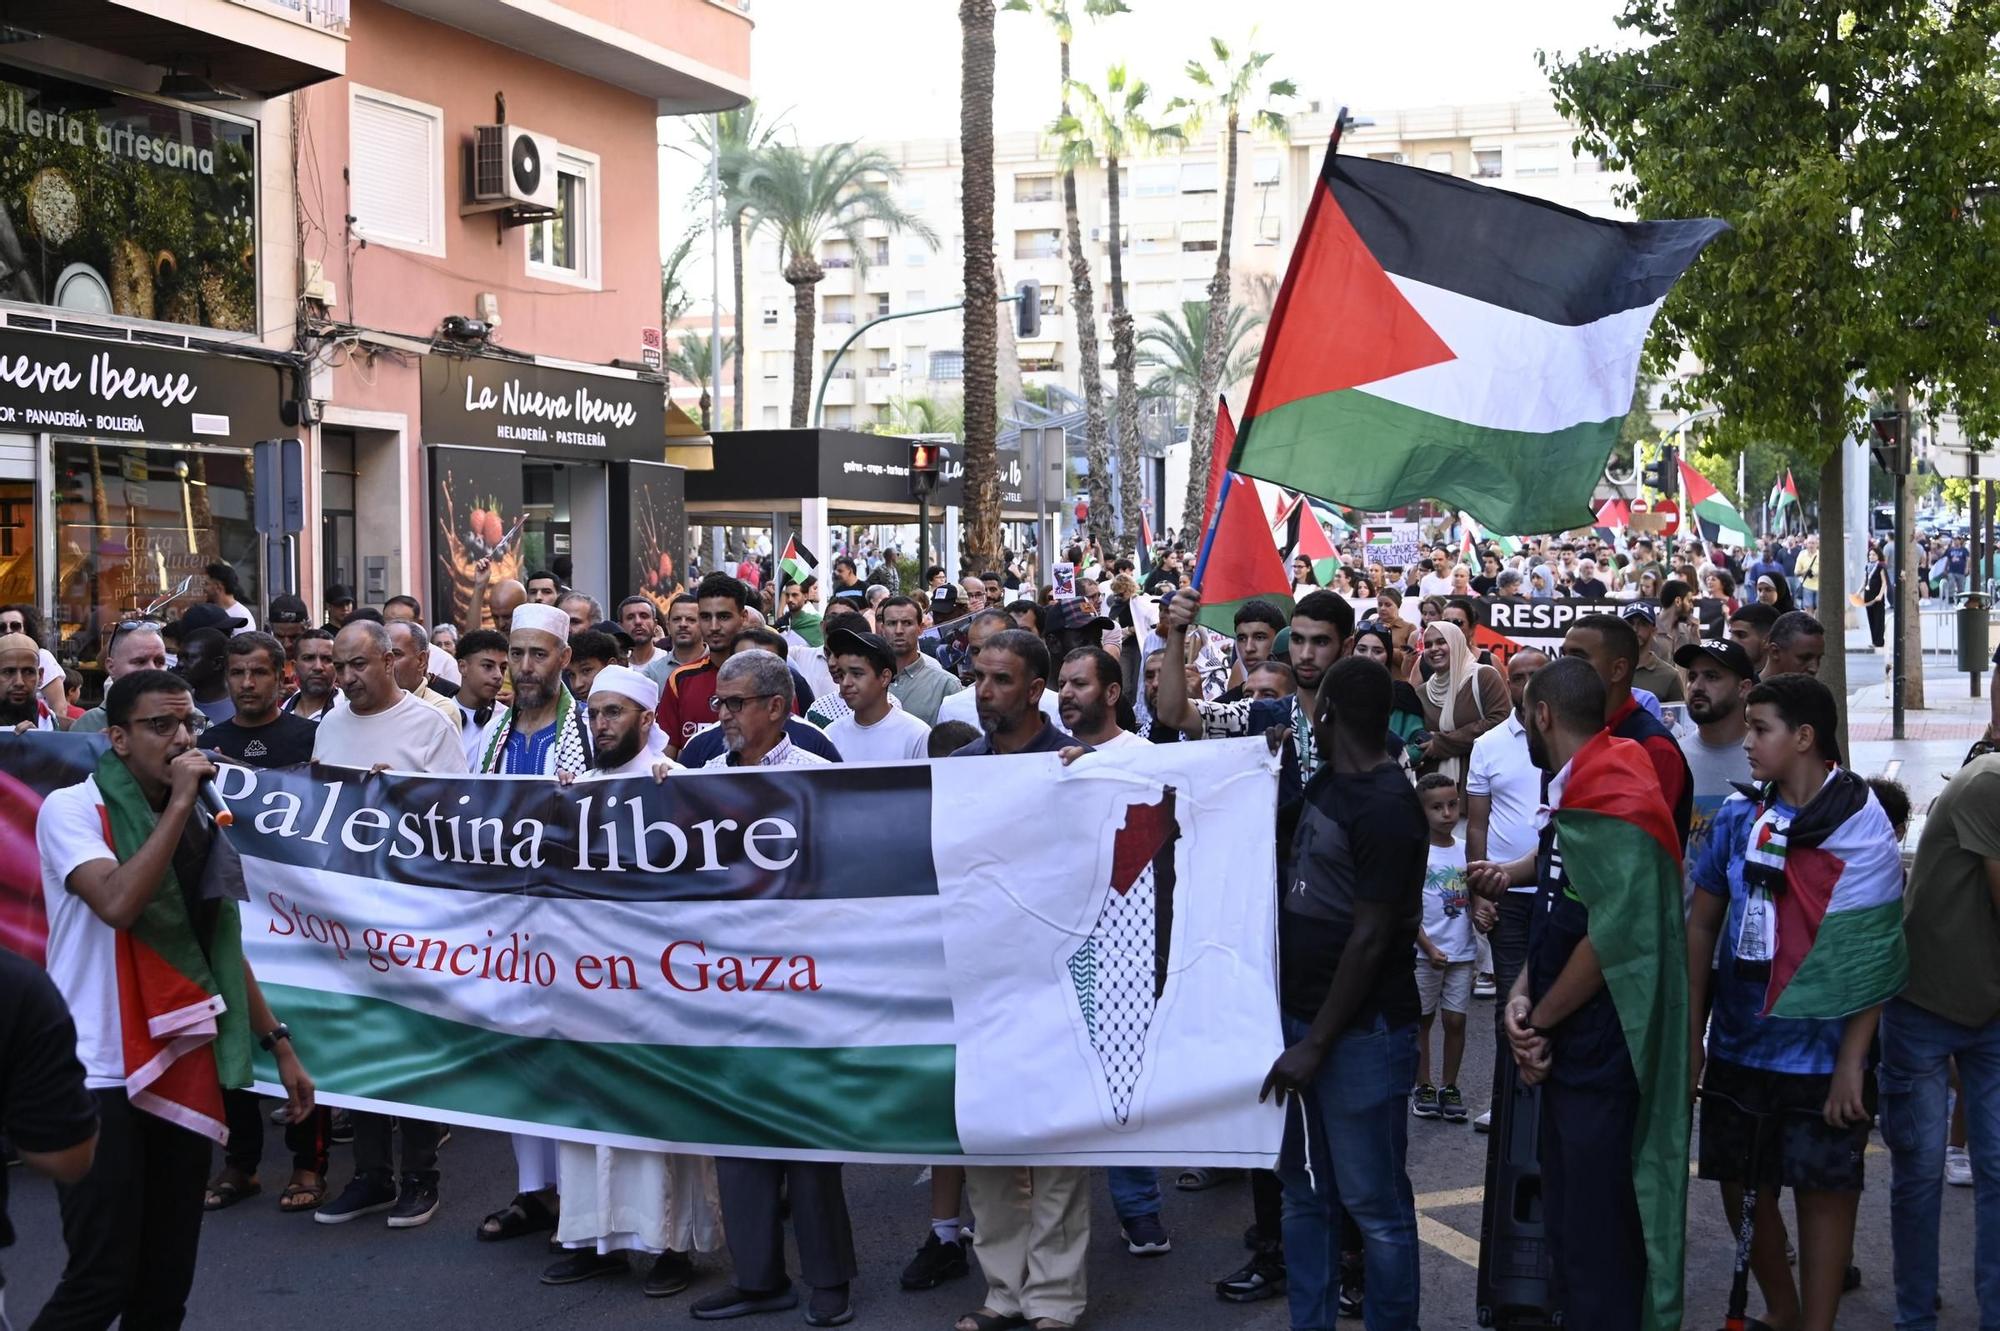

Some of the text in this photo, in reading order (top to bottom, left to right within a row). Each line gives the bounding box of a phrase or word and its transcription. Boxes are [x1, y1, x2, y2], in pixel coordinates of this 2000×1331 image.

[96, 125, 214, 175] artesana
[90, 351, 198, 408] Ibense
[466, 375, 637, 429] La Nueva Ibense
[26, 408, 88, 428] PANADERÍA
[96, 414, 145, 433] BOLLERÍA
[497, 425, 606, 447] HELADERÍA PASTELERÍA
[124, 533, 172, 551] Carta
[155, 551, 211, 569] luten
[213, 761, 799, 874] Palestina libre
[267, 891, 824, 993] Stop gencidio en Gaza
